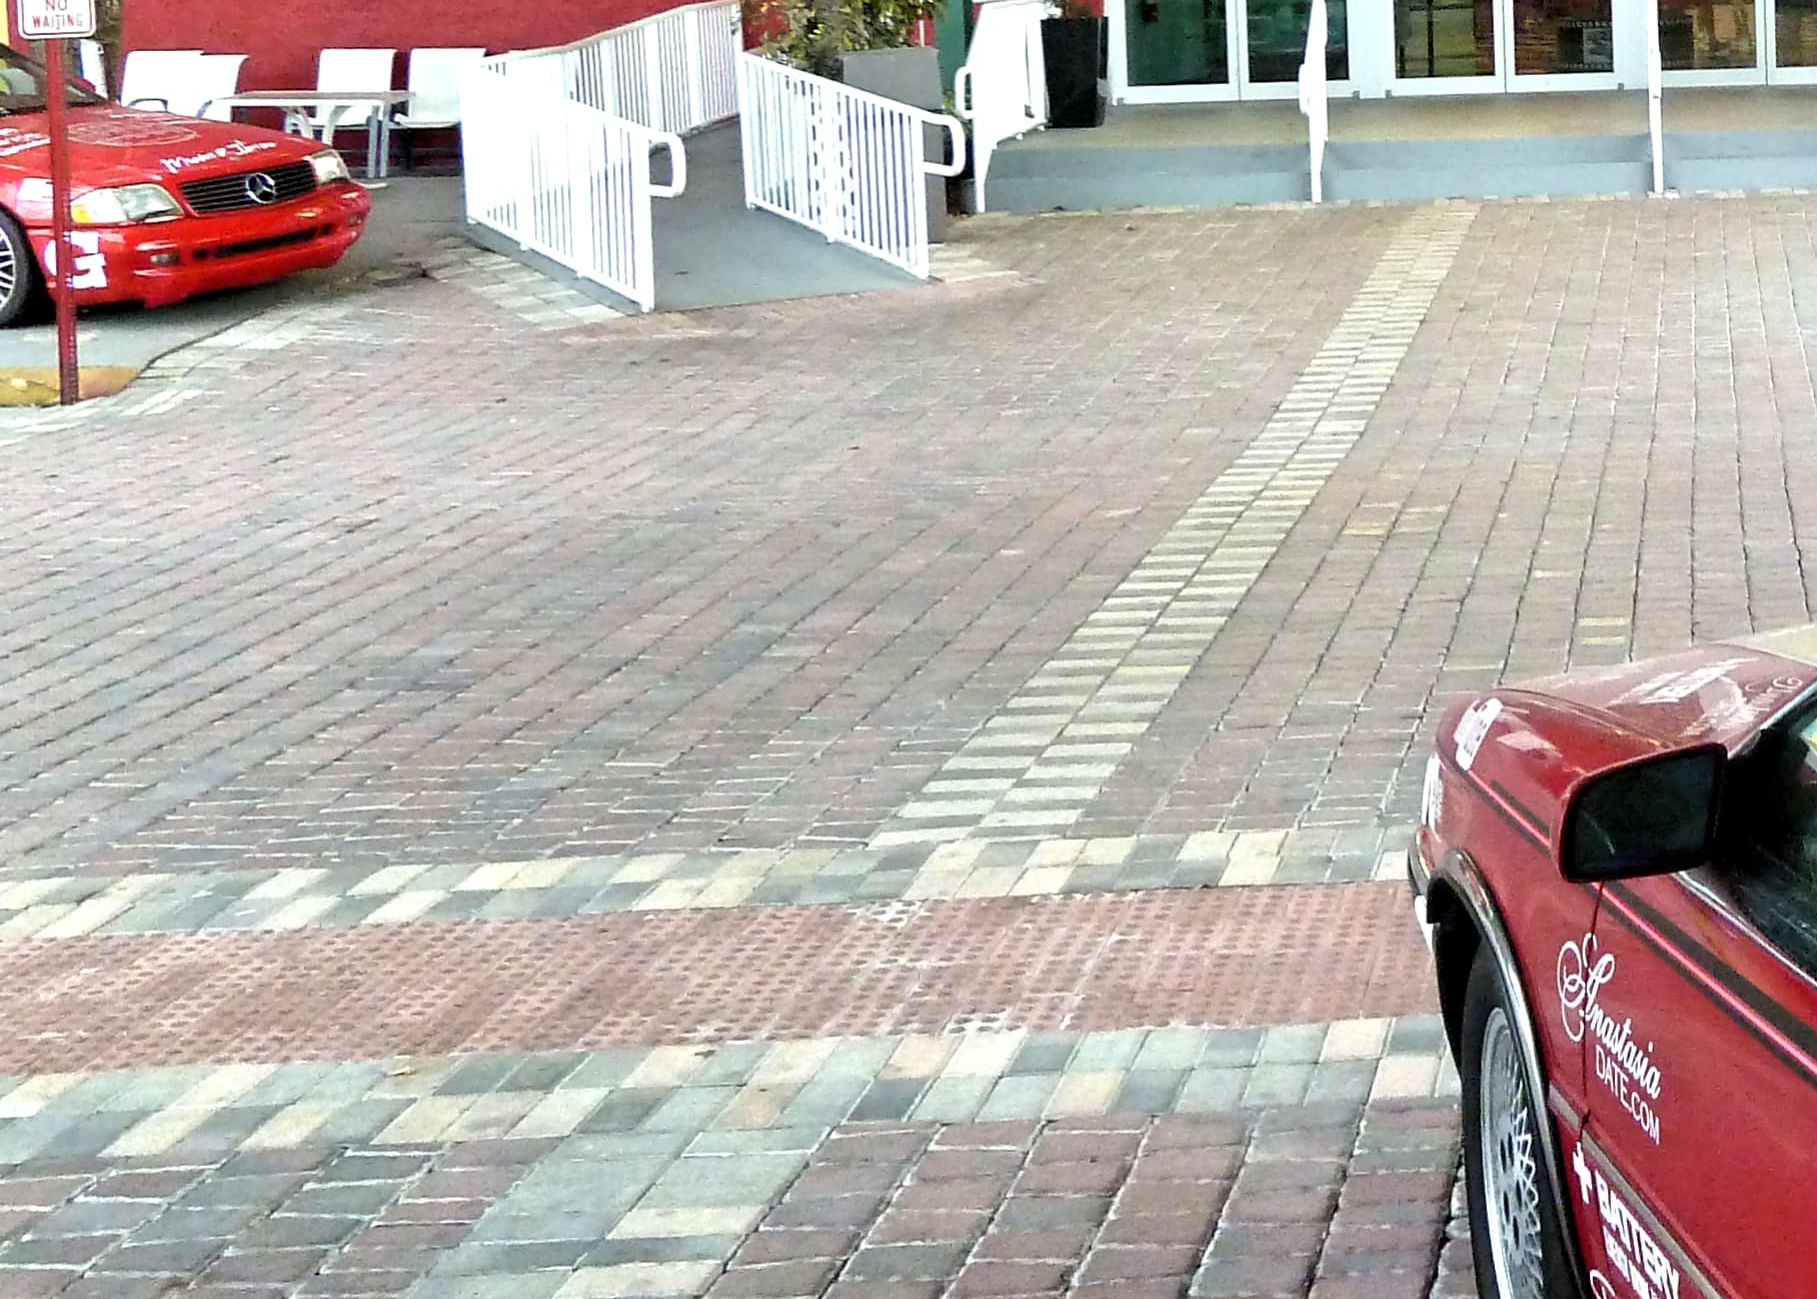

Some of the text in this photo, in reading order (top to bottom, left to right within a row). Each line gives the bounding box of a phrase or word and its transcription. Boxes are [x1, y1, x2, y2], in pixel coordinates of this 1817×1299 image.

[32, 13, 83, 29] WAITING
[1556, 932, 1661, 1100] Anastasia
[1595, 1043, 1661, 1146] DATE.COM
[1594, 1168, 1680, 1299] BATTERY
